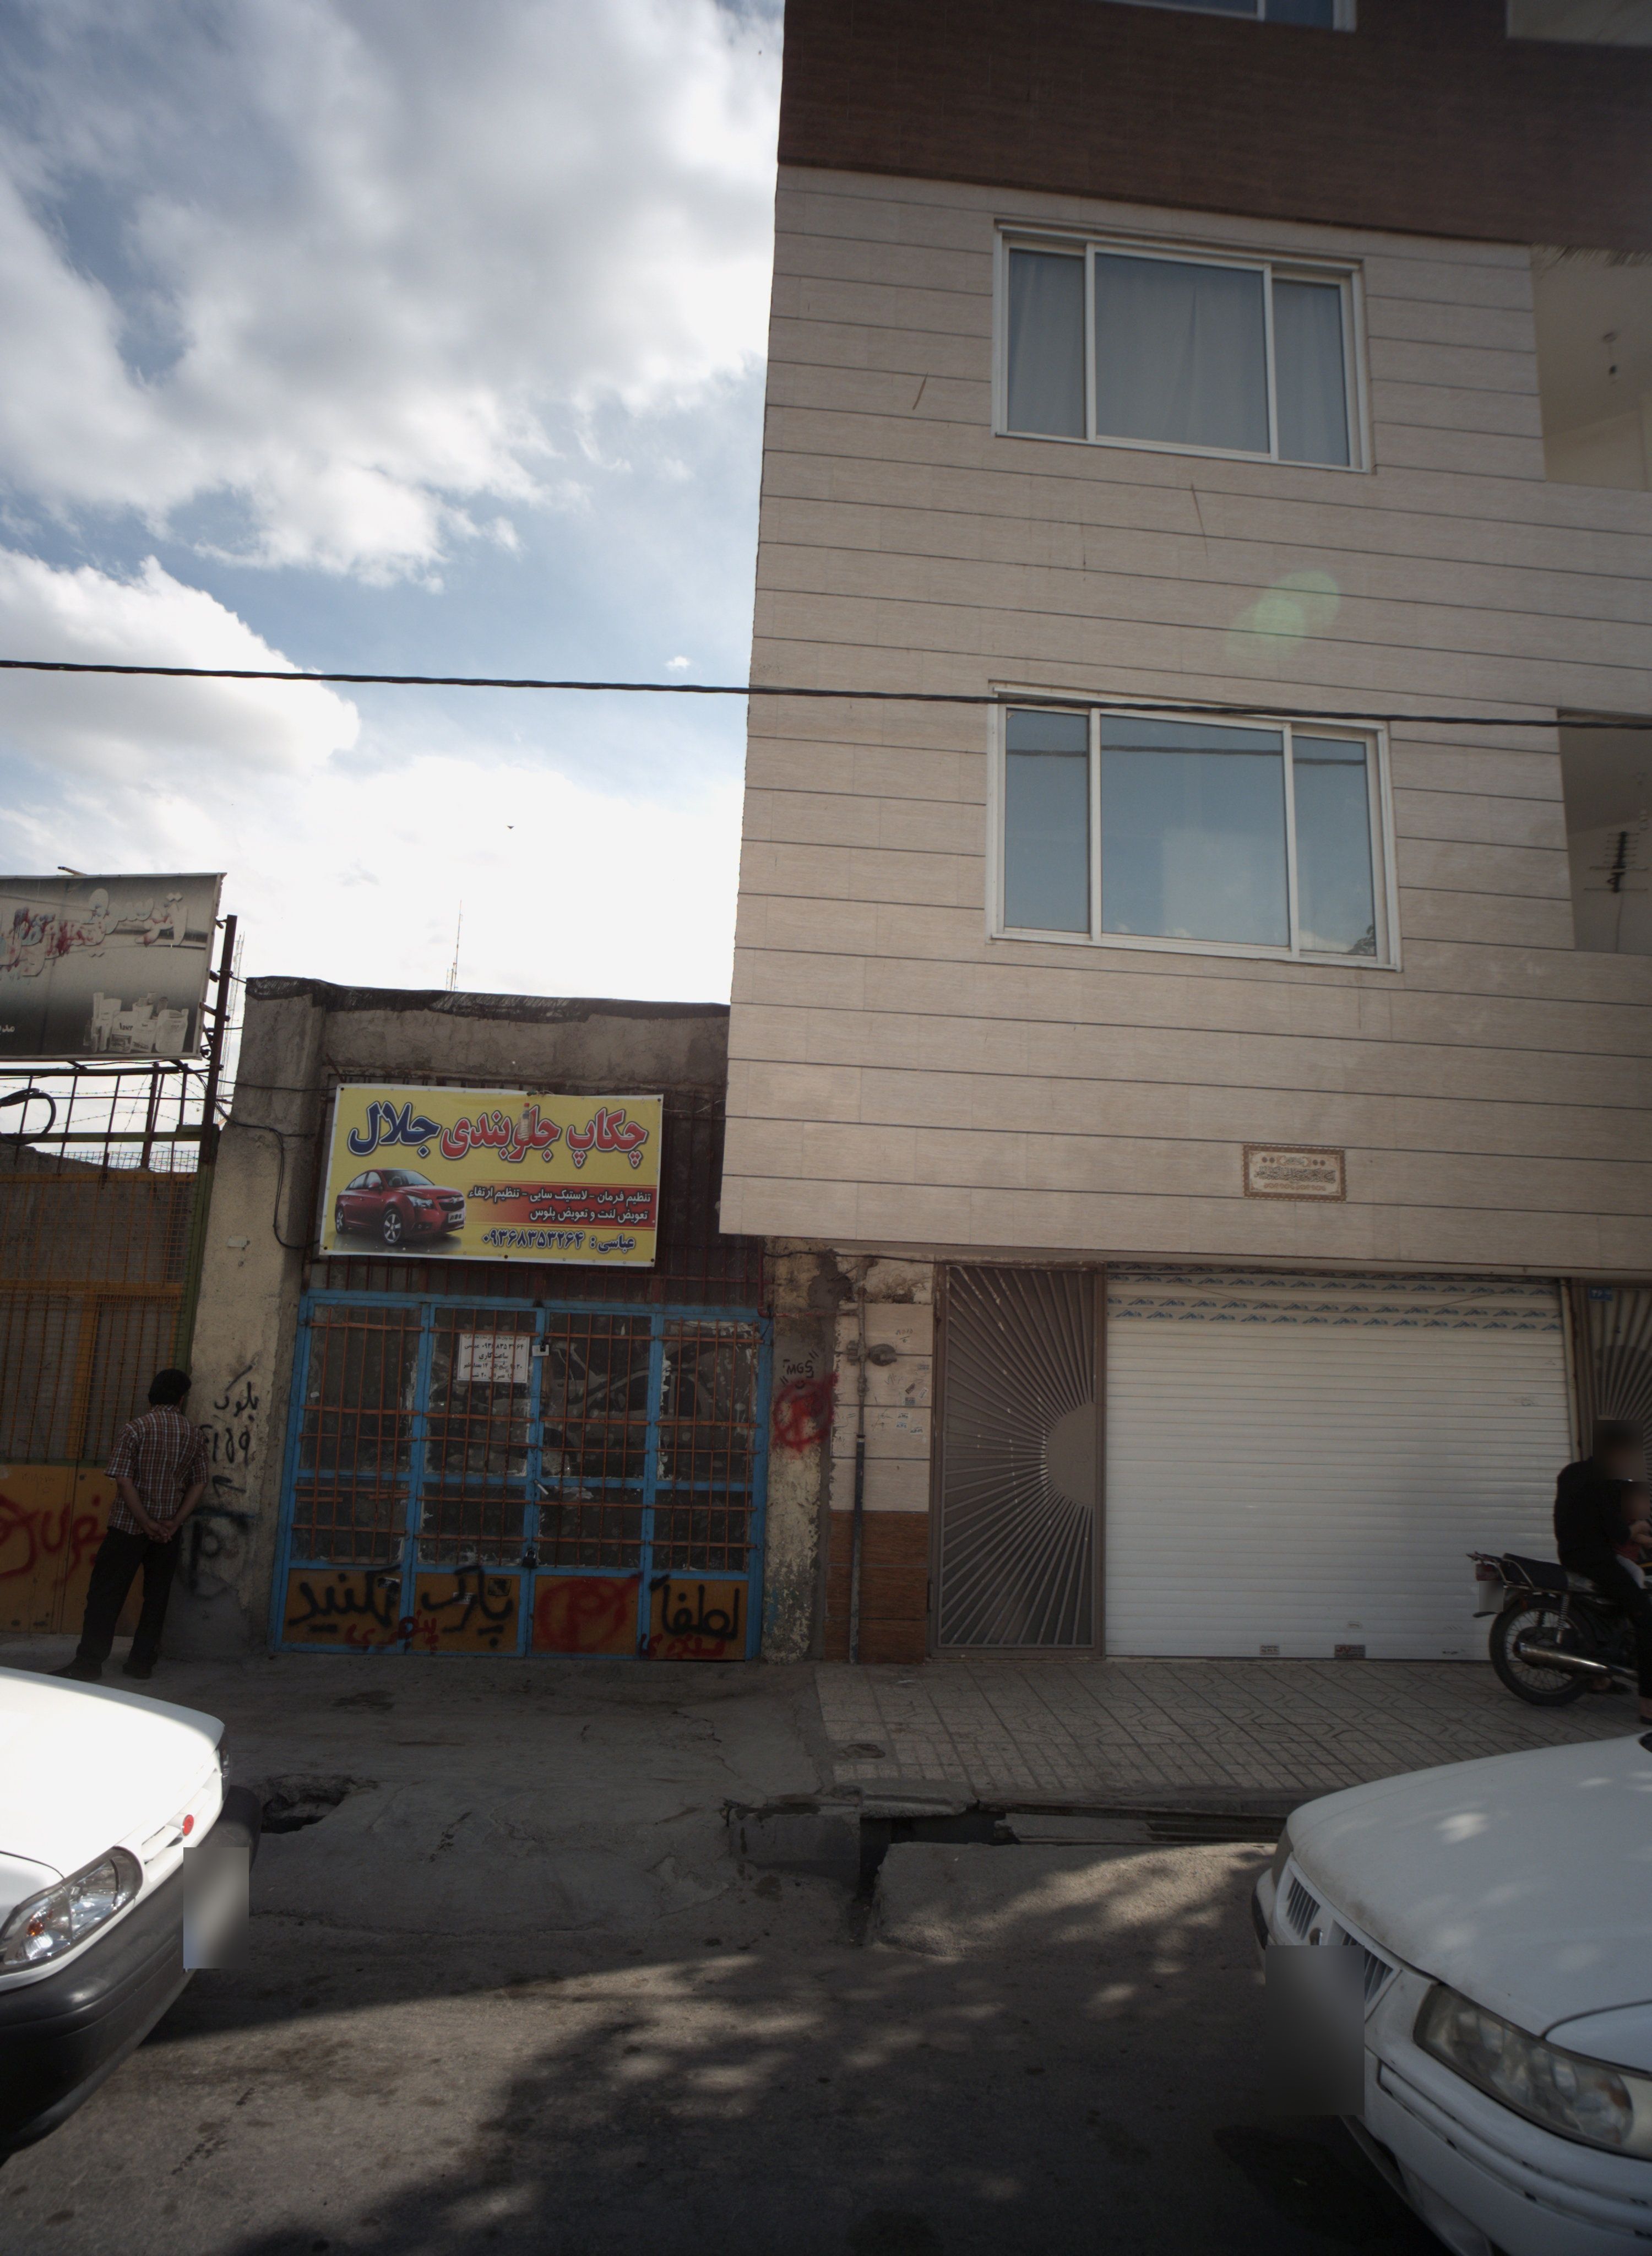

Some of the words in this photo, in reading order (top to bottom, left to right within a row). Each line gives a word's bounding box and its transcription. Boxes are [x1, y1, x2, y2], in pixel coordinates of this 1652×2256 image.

[347, 1101, 441, 1158] جلال
[441, 1105, 562, 1163] جلوبندی
[567, 1107, 649, 1168] چکاپ
[494, 1187, 520, 1203] تنظیم
[530, 1188, 553, 1202] سایی
[555, 1189, 588, 1203] لاستیک
[597, 1190, 624, 1205] فرمان
[626, 1191, 651, 1207] تنظیم
[530, 1207, 556, 1221] پلوس
[557, 1208, 588, 1222] تعویض
[589, 1212, 595, 1221] و
[597, 1209, 616, 1220] لنت
[618, 1210, 648, 1224] تعویض
